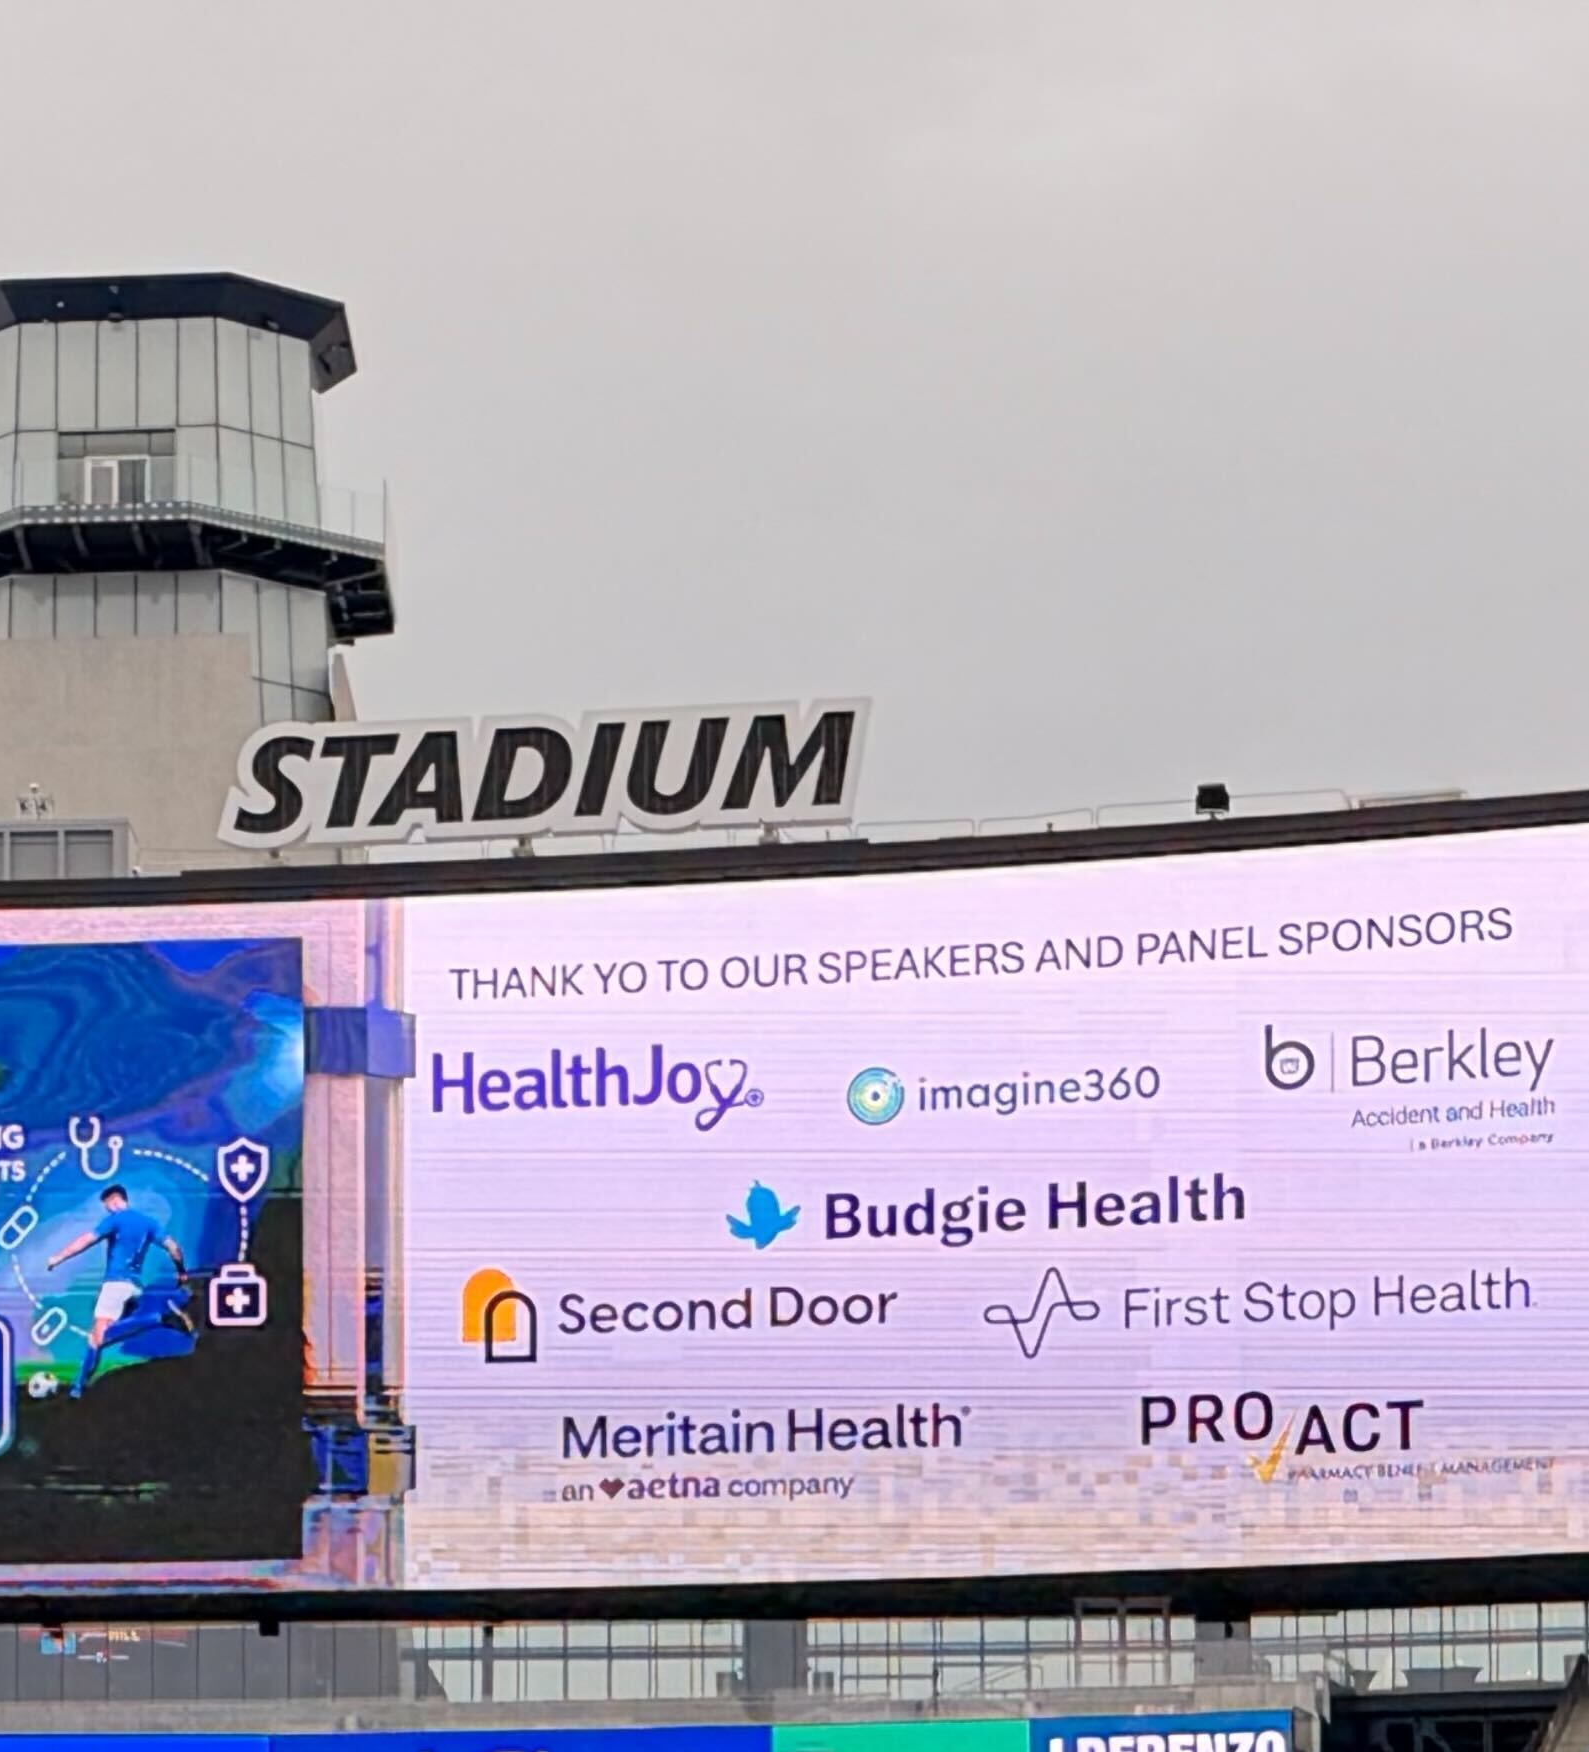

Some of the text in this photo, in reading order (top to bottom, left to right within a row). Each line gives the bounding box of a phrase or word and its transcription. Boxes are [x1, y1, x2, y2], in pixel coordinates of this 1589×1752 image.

[234, 711, 856, 833] STADIUM
[449, 907, 1515, 1000] THANK YO TO OUR SPEAKERS AND PANEL SPONSORS
[431, 1044, 765, 1132] HealthJoy
[918, 1066, 1161, 1116] imagine360
[1350, 1028, 1555, 1092] Berkley
[1351, 1096, 1556, 1128] Accident and Health
[825, 1173, 1246, 1247] Budgie Health
[557, 1286, 898, 1335] Second Door
[1124, 1267, 1532, 1331] First Stop Health
[562, 1403, 963, 1458] Meritain Health
[561, 1473, 855, 1501] an aetna company
